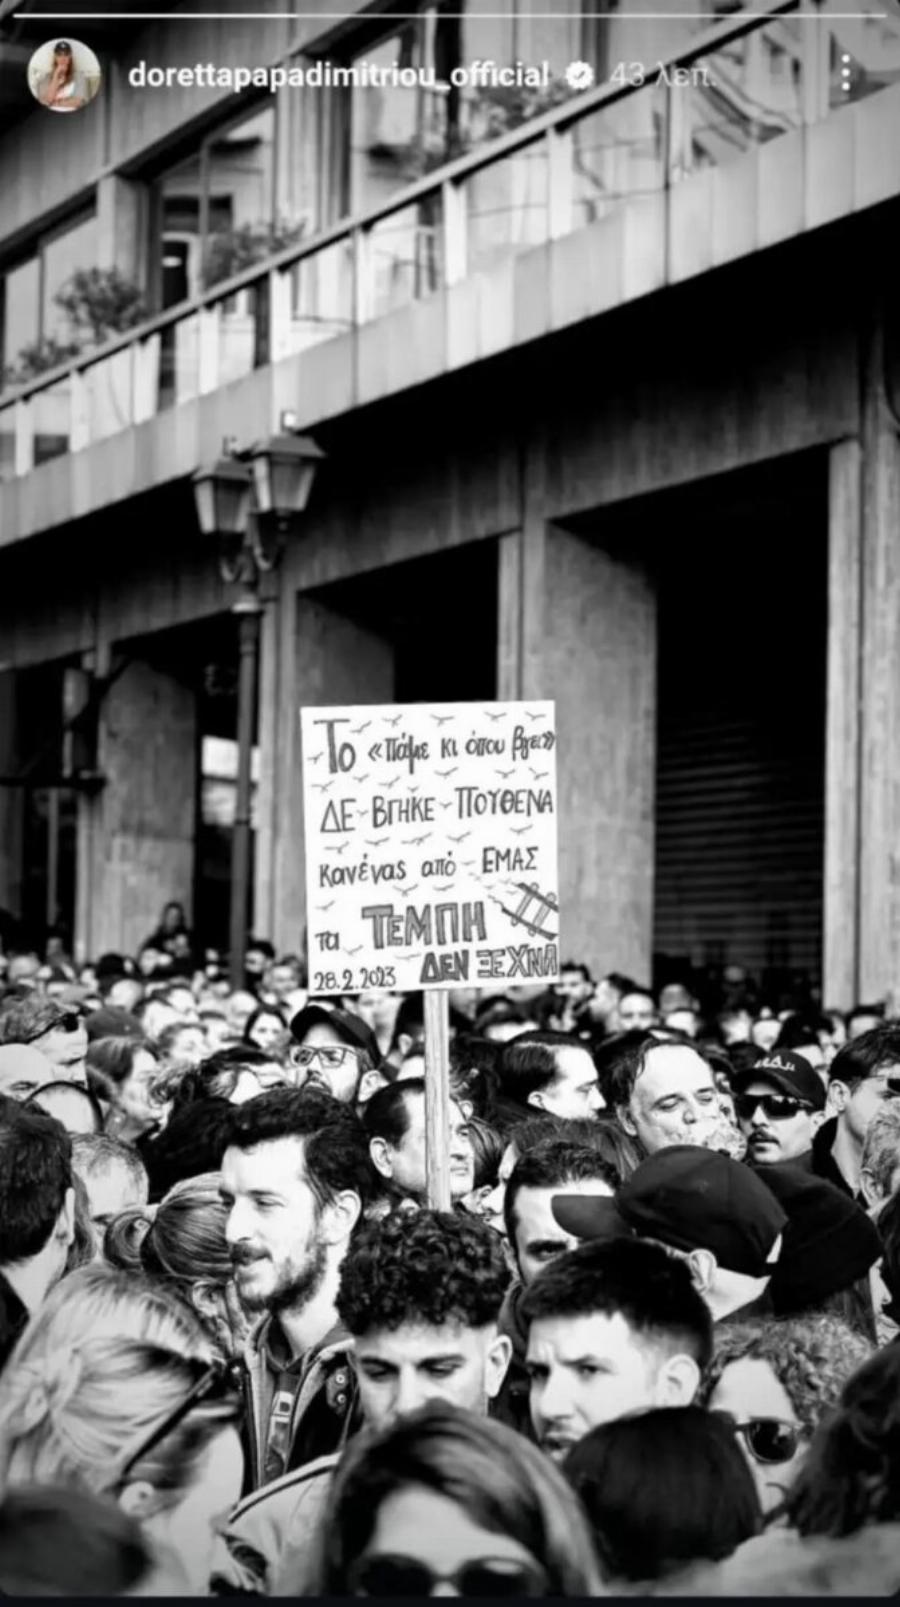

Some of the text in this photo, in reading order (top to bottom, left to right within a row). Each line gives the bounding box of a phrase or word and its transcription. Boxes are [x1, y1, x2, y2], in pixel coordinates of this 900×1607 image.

[465, 729, 505, 757] όπου
[320, 786, 554, 833] ΔΕ ΒΓΗΚΕ ΠΟΥΘΕΝΑ
[421, 851, 457, 878] από
[482, 846, 539, 874] ΕΜΑΣ
[361, 901, 488, 950] ΤΕΜΠΗ
[314, 966, 397, 992] 28.2.2023
[420, 950, 469, 983] ΔΕΝ
